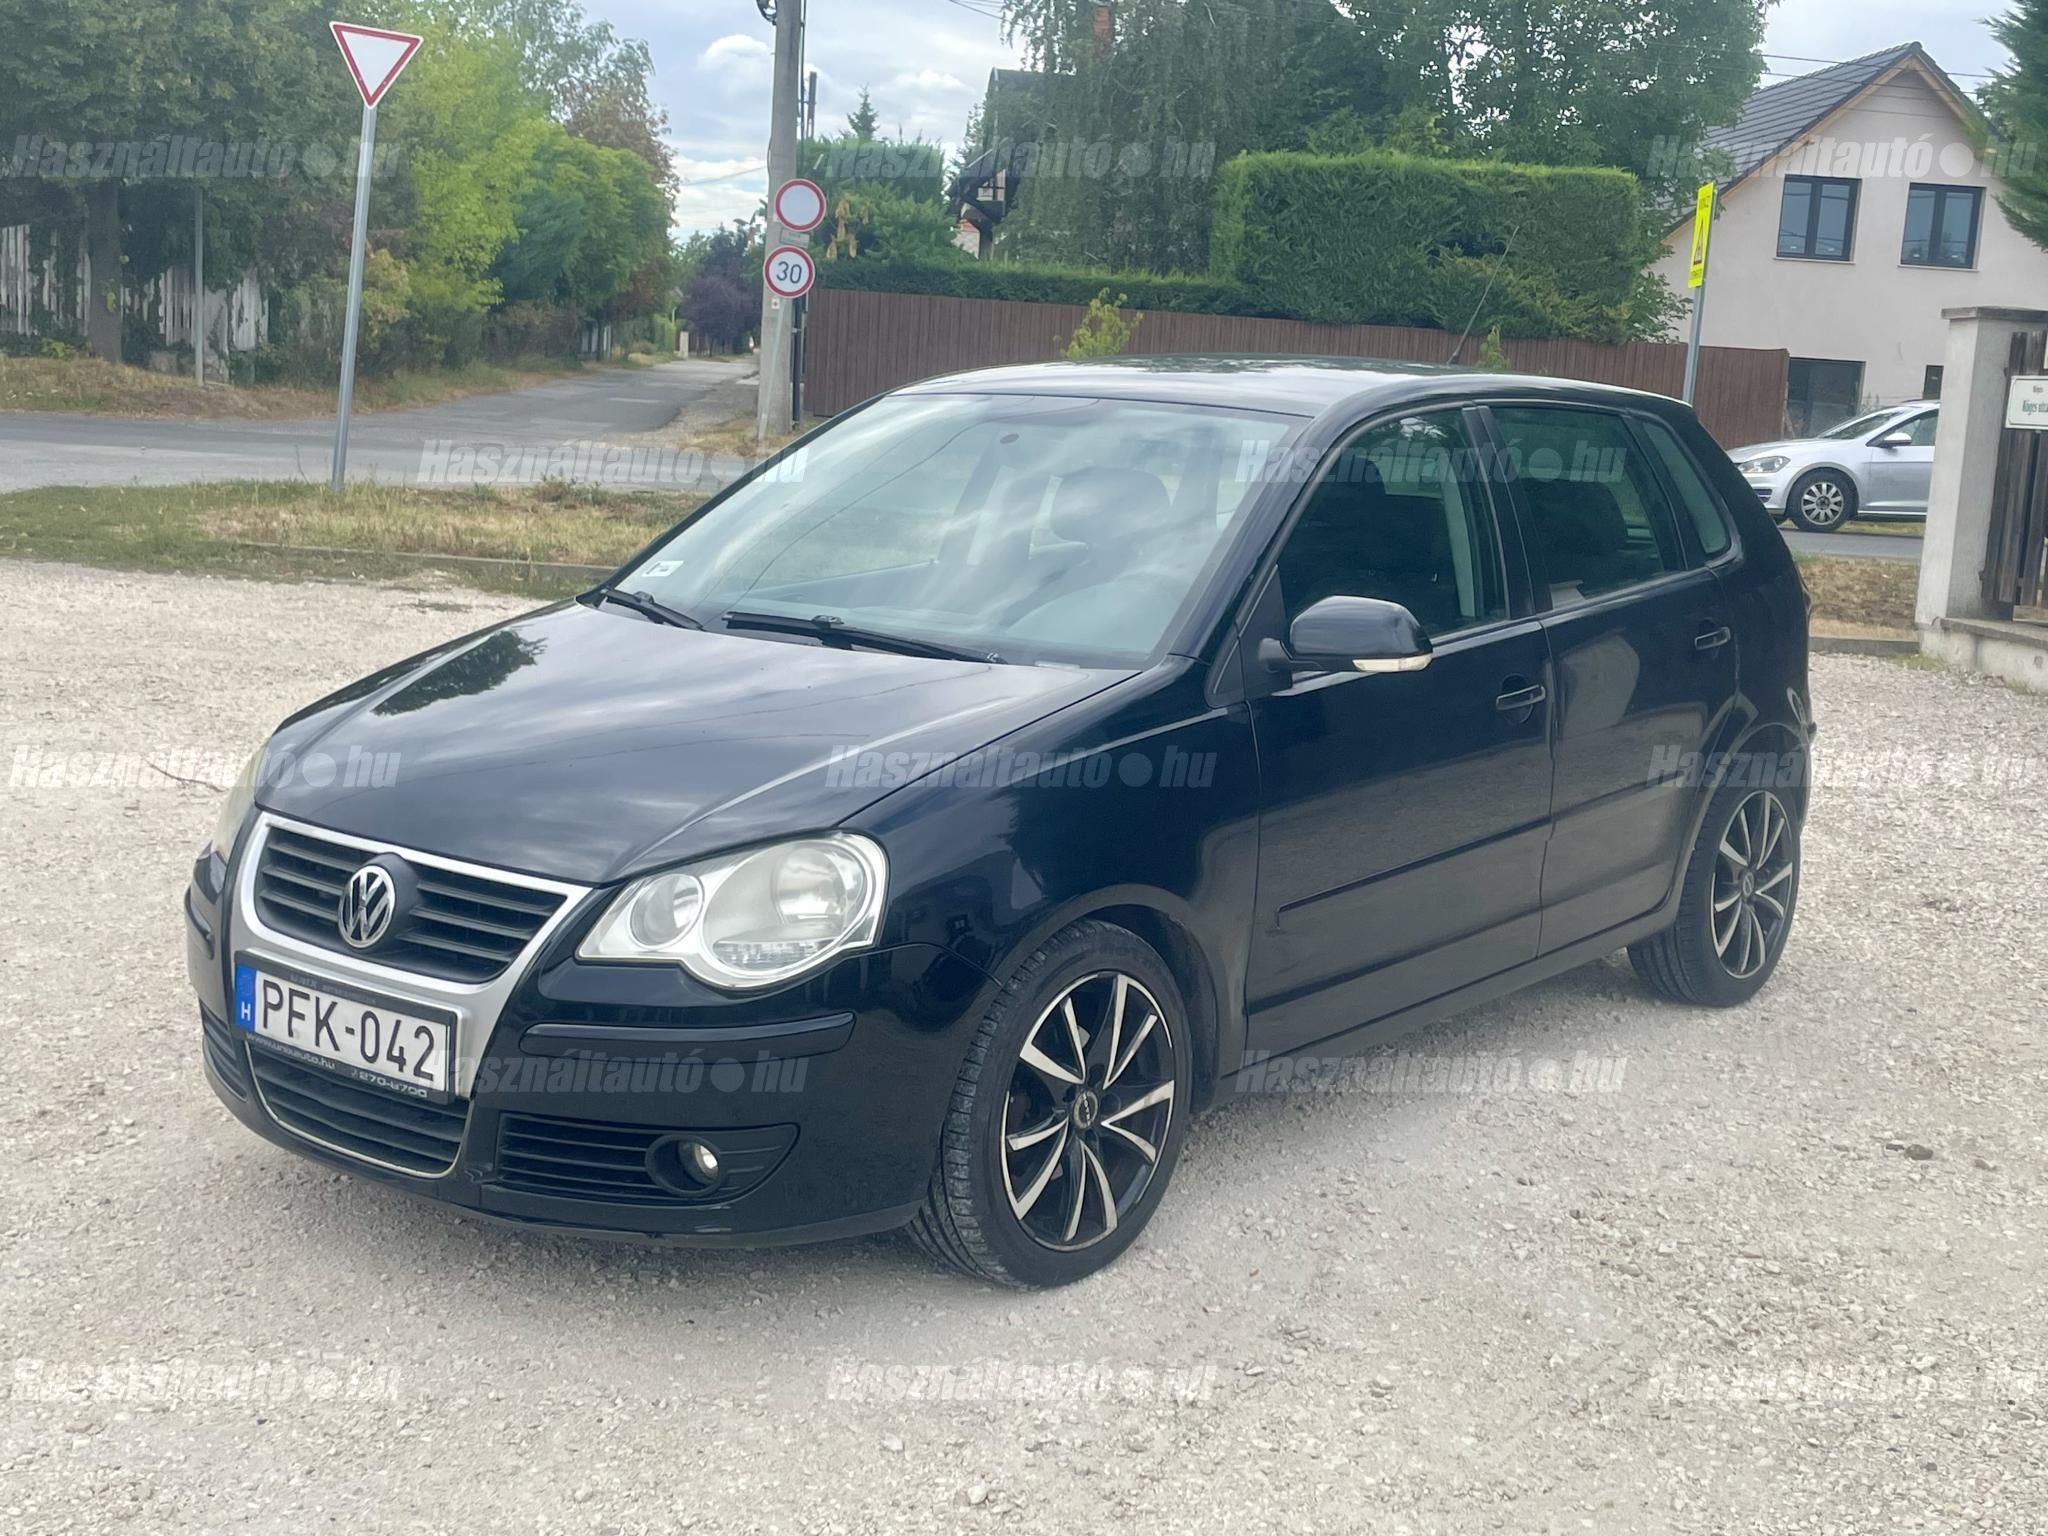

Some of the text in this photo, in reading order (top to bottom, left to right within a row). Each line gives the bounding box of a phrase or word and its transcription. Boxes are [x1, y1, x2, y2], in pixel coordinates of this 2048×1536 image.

[776, 260, 802, 284] 30
[241, 1002, 251, 1021] H
[263, 979, 434, 1082] PFK-042
